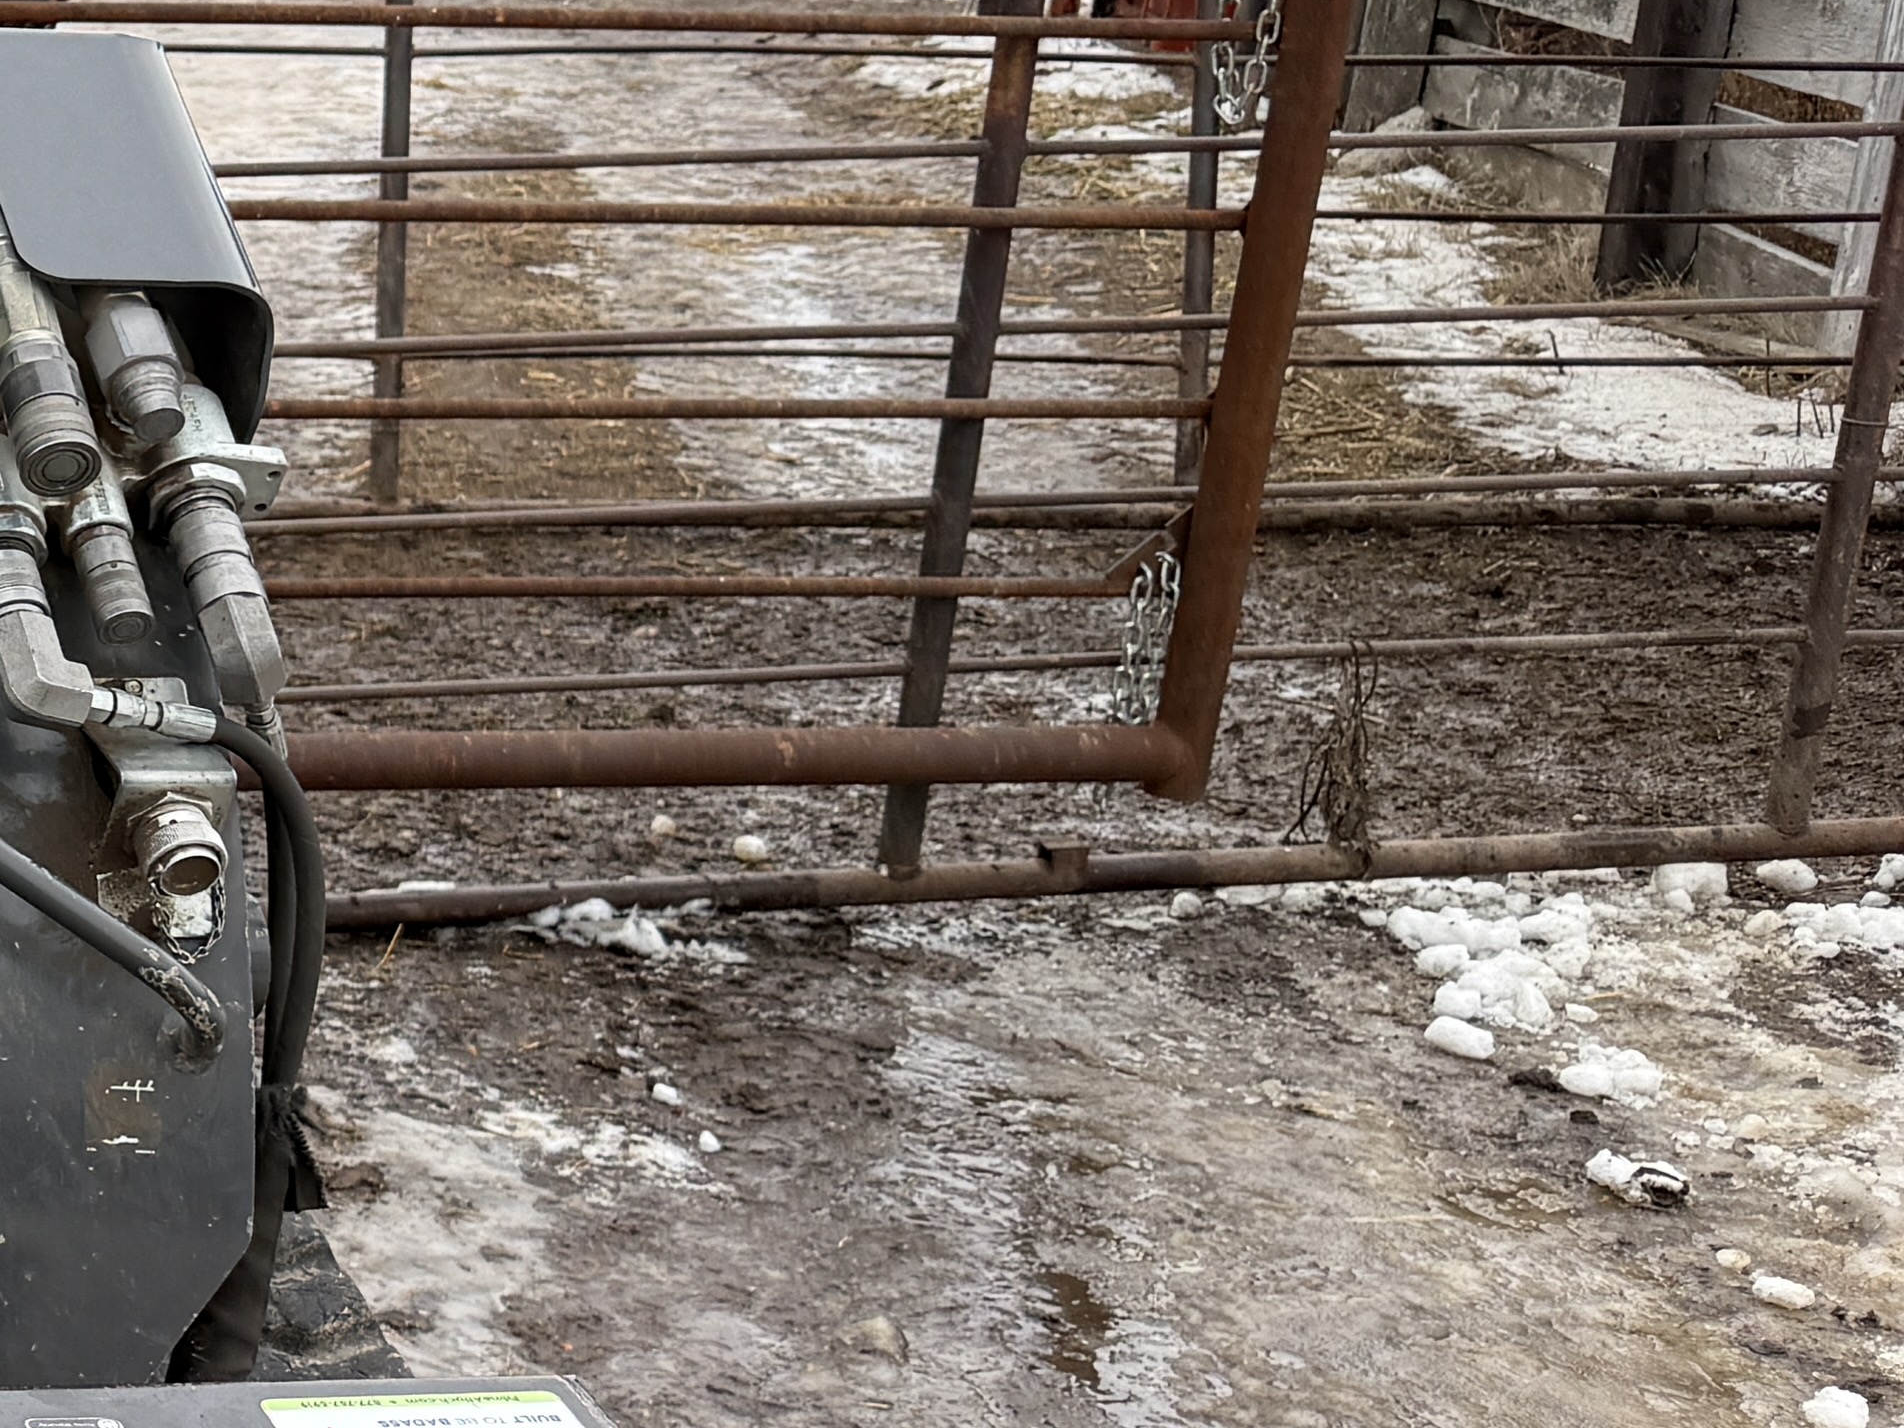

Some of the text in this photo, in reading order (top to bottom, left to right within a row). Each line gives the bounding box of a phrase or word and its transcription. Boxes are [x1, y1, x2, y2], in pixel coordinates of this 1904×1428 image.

[377, 1414, 561, 1428] BUILT TO BE BADASS
